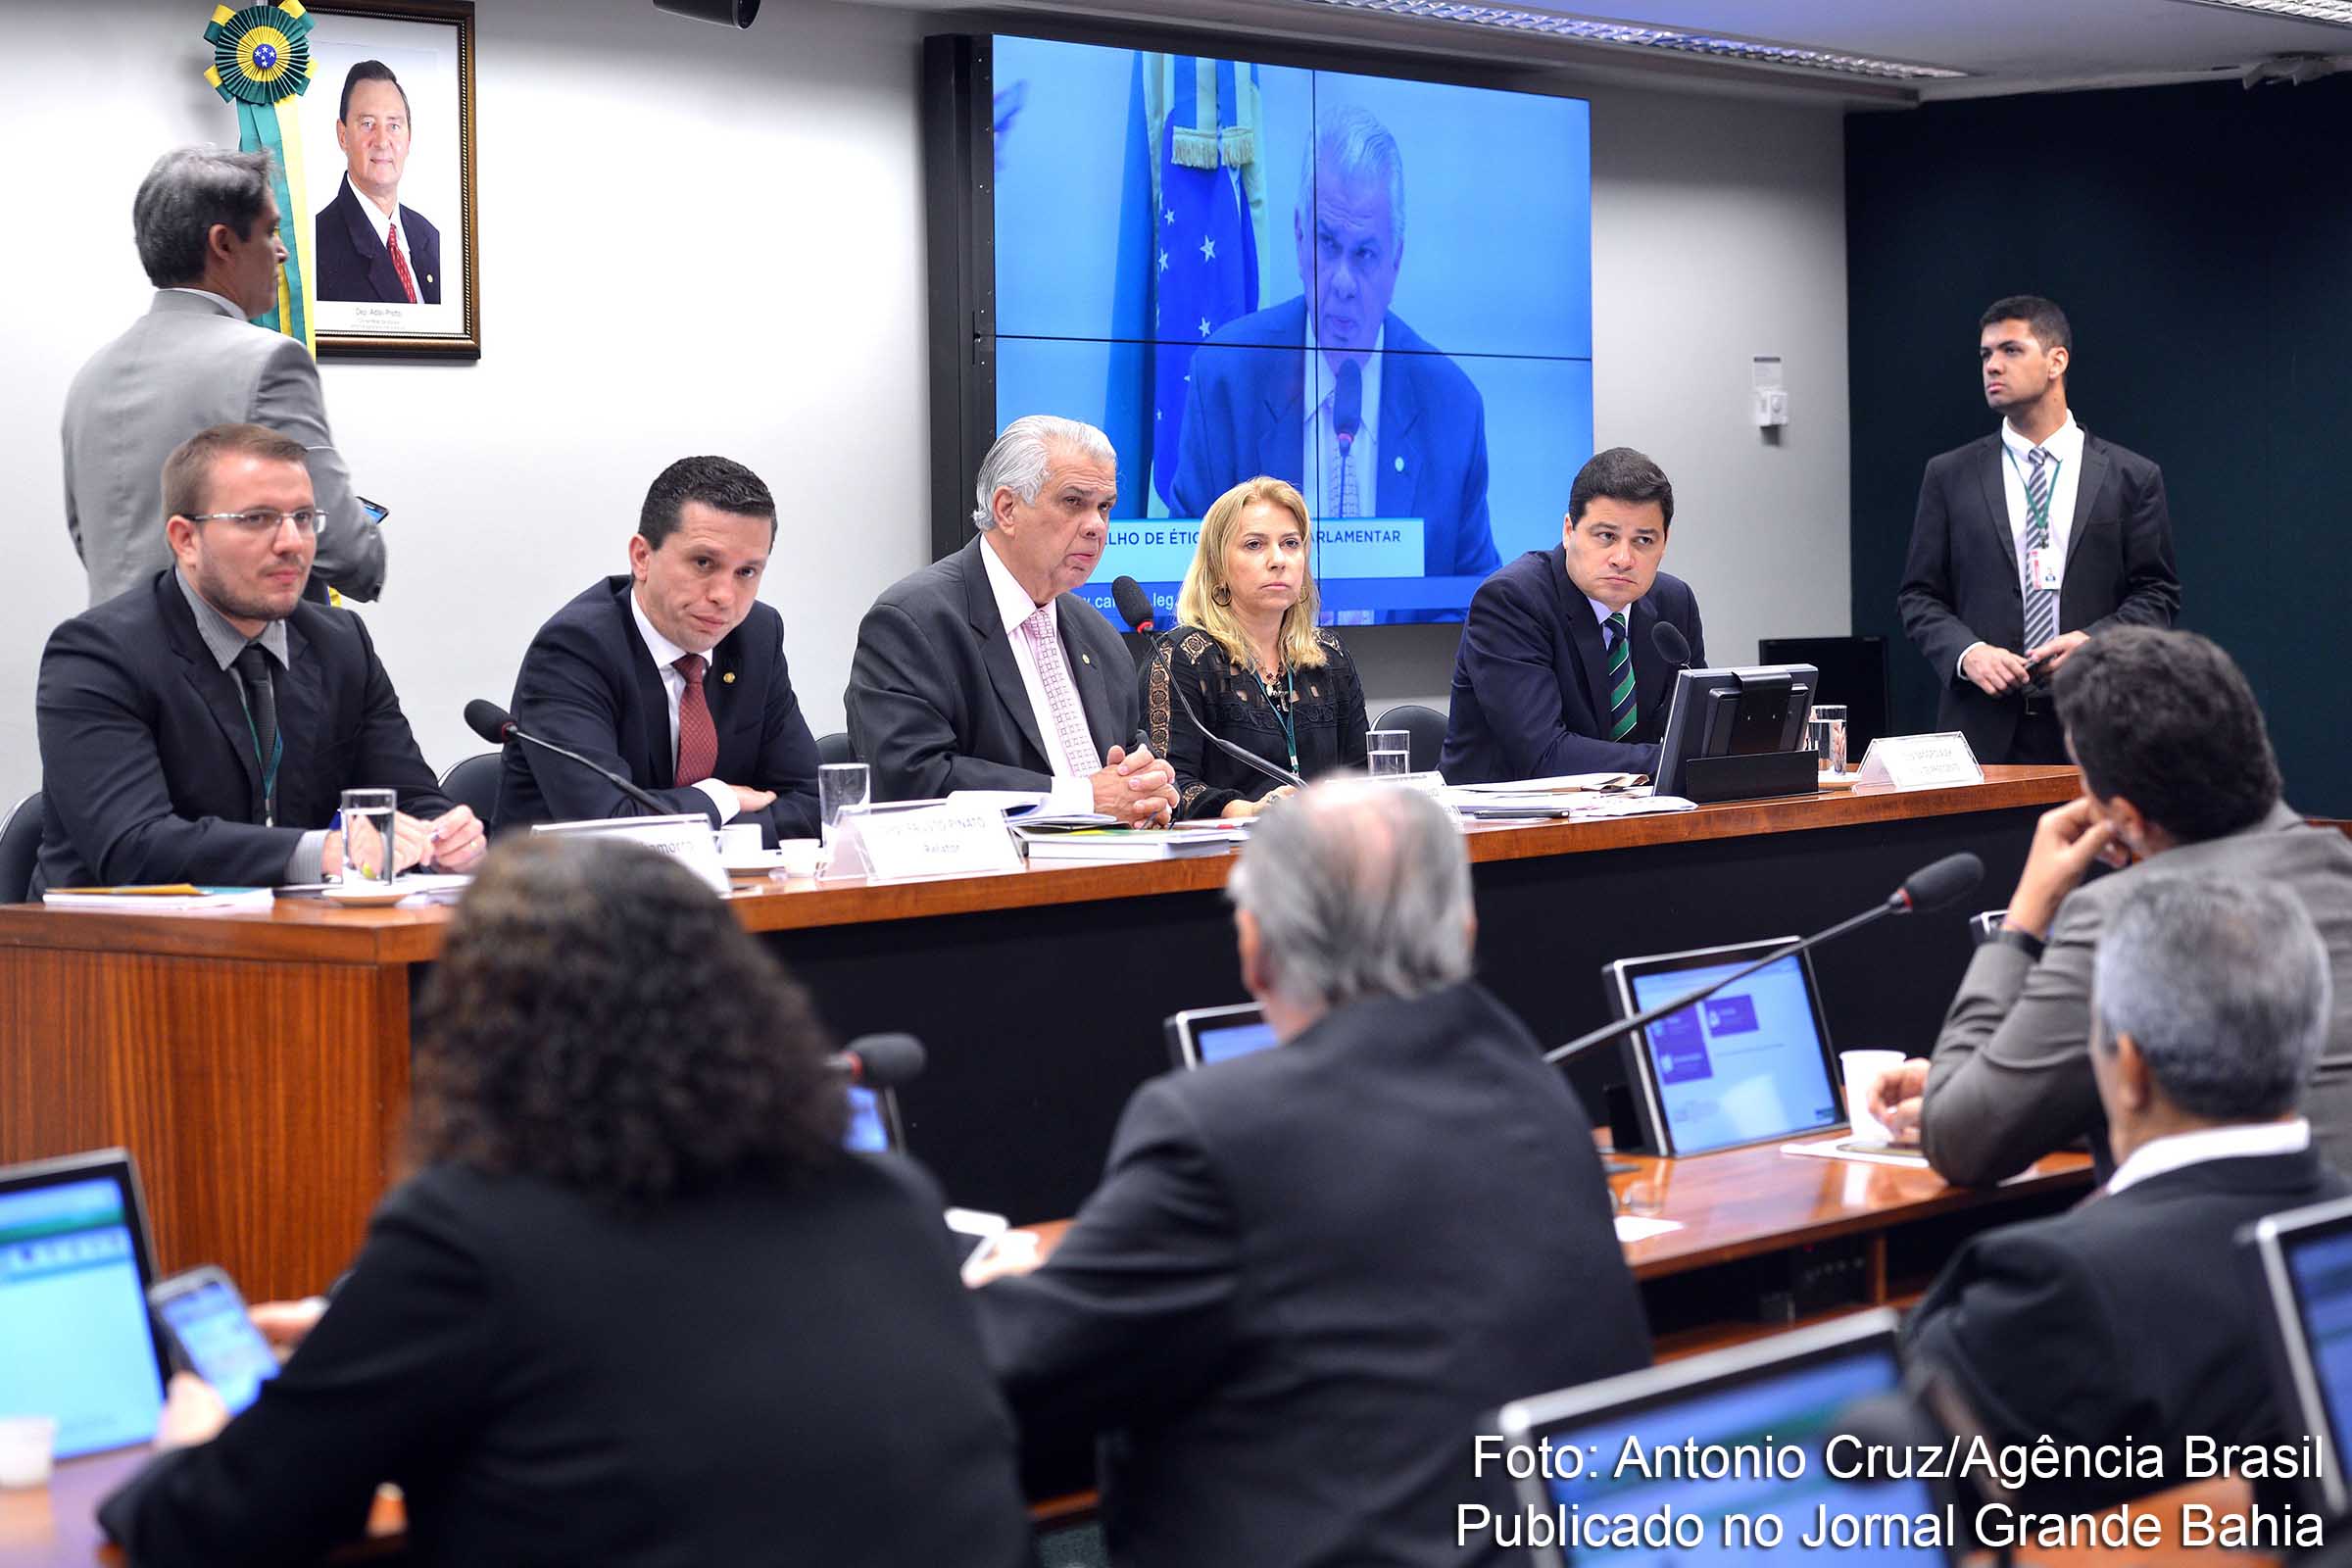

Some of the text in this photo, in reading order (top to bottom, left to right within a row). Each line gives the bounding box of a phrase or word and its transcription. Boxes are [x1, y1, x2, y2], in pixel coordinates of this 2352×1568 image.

[1105, 532, 1140, 545] LHO
[1145, 532, 1164, 545] DE
[1310, 530, 1401, 543] RLAMENTAR
